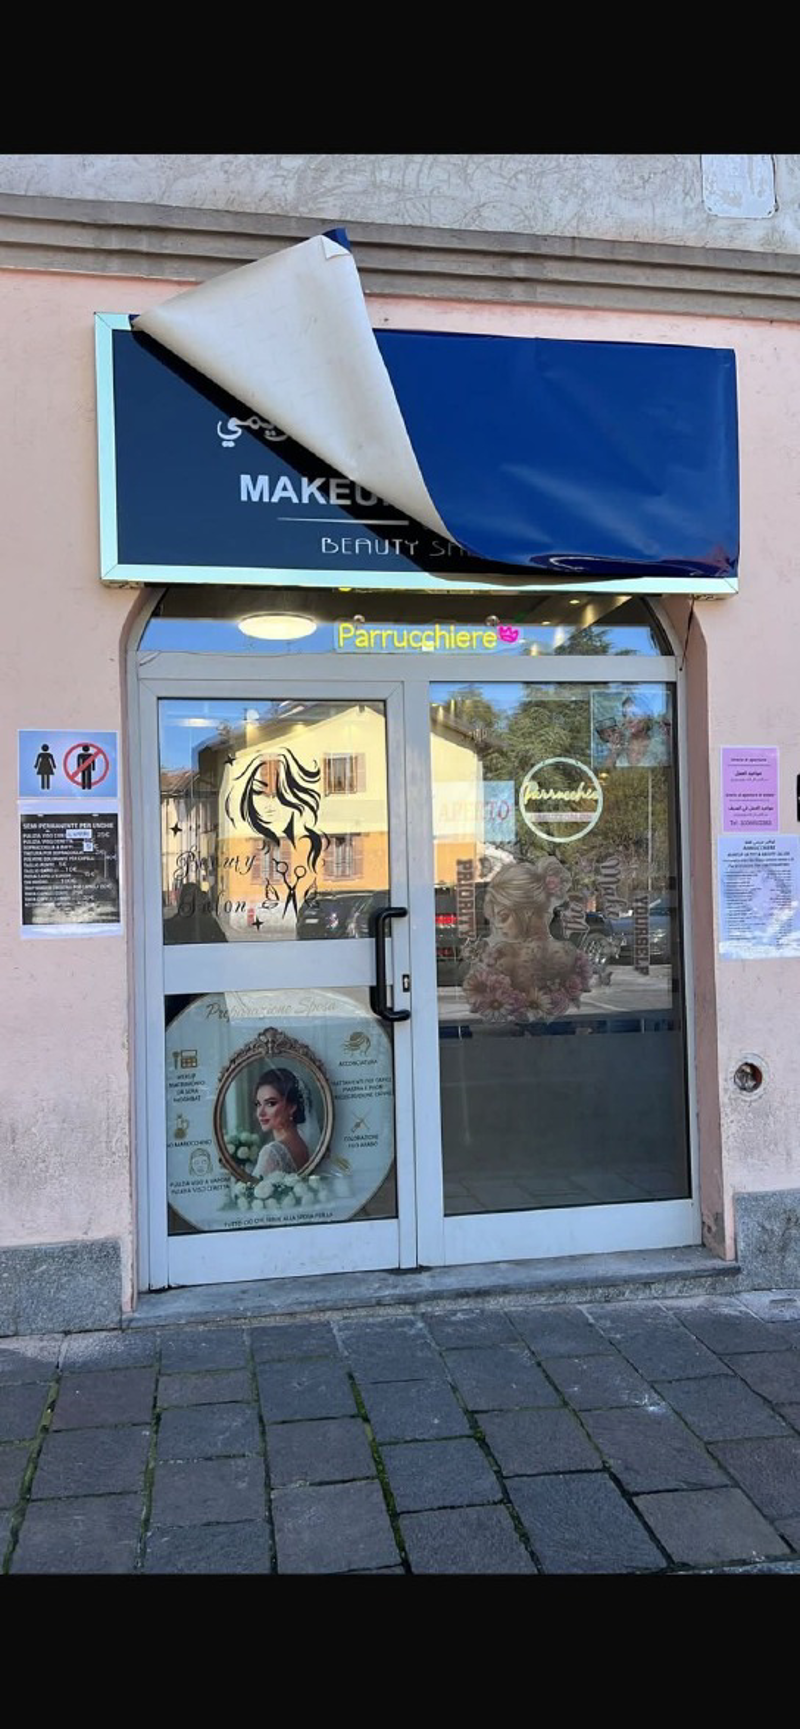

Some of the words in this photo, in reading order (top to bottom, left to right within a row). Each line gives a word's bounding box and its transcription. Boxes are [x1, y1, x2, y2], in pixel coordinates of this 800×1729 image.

[240, 474, 390, 505] MAKEU
[321, 537, 418, 556] BEAUTY
[338, 622, 497, 648] Parrucchiere
[457, 859, 476, 938] PRIORITY
[635, 894, 650, 976] YOURSELF
